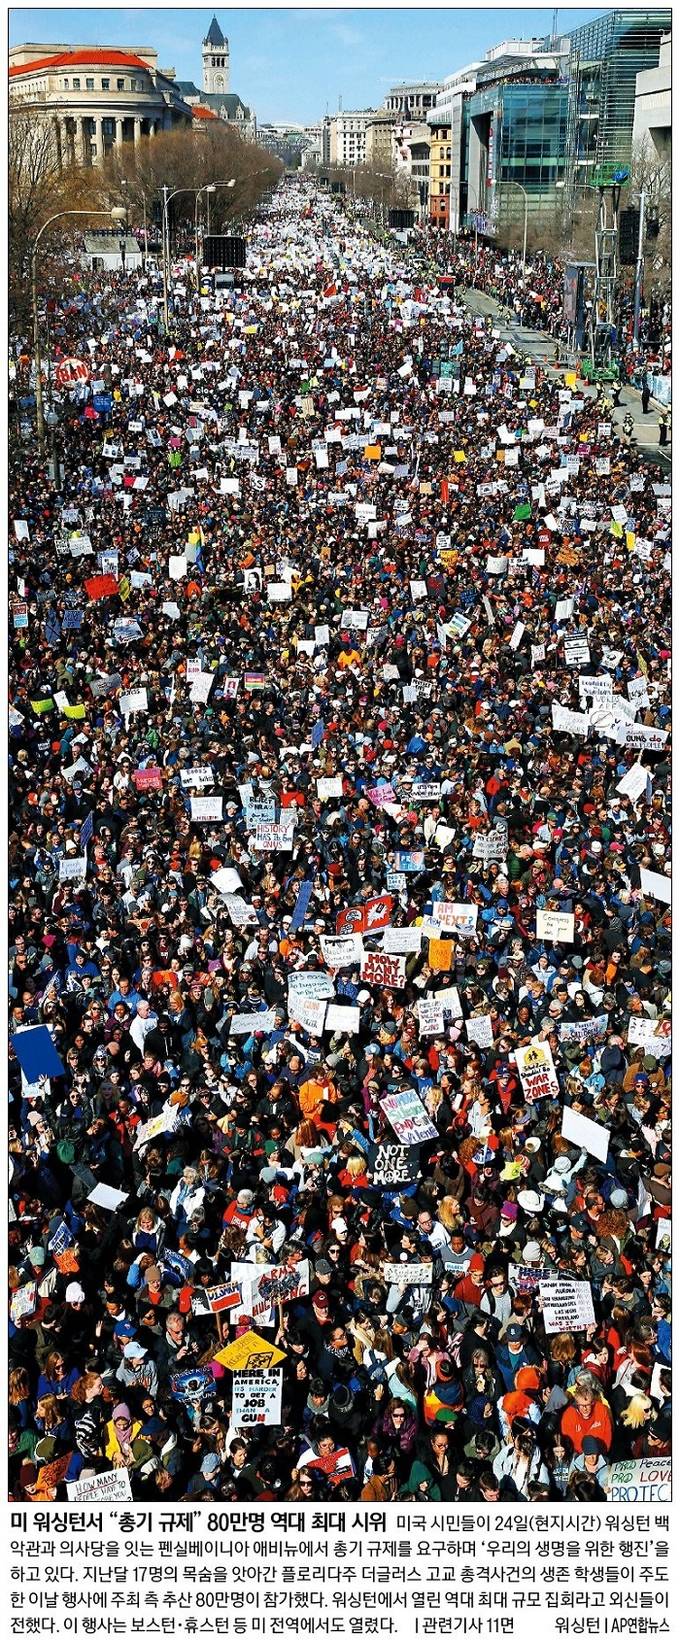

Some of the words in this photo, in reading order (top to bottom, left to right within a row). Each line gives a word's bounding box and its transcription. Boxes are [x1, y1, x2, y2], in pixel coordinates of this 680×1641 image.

[256, 824, 289, 833] HISTORY
[367, 953, 400, 967] HOW
[364, 962, 401, 977] MANY
[361, 971, 406, 987] MORE?
[527, 1073, 550, 1088] WAR
[524, 1081, 560, 1100] ZONES
[376, 1144, 410, 1160] NOT.
[374, 1156, 413, 1171] ONE.
[259, 1263, 297, 1284] ARMS
[233, 1369, 266, 1379] HERE,
[268, 1368, 281, 1377] IN
[234, 1378, 280, 1387] AMERICA,
[243, 1399, 265, 1408] JOB
[241, 1413, 266, 1423] GUN
[75, 1479, 95, 1494] HOW
[96, 1472, 118, 1487] MANY
[610, 1472, 634, 1483] PRO
